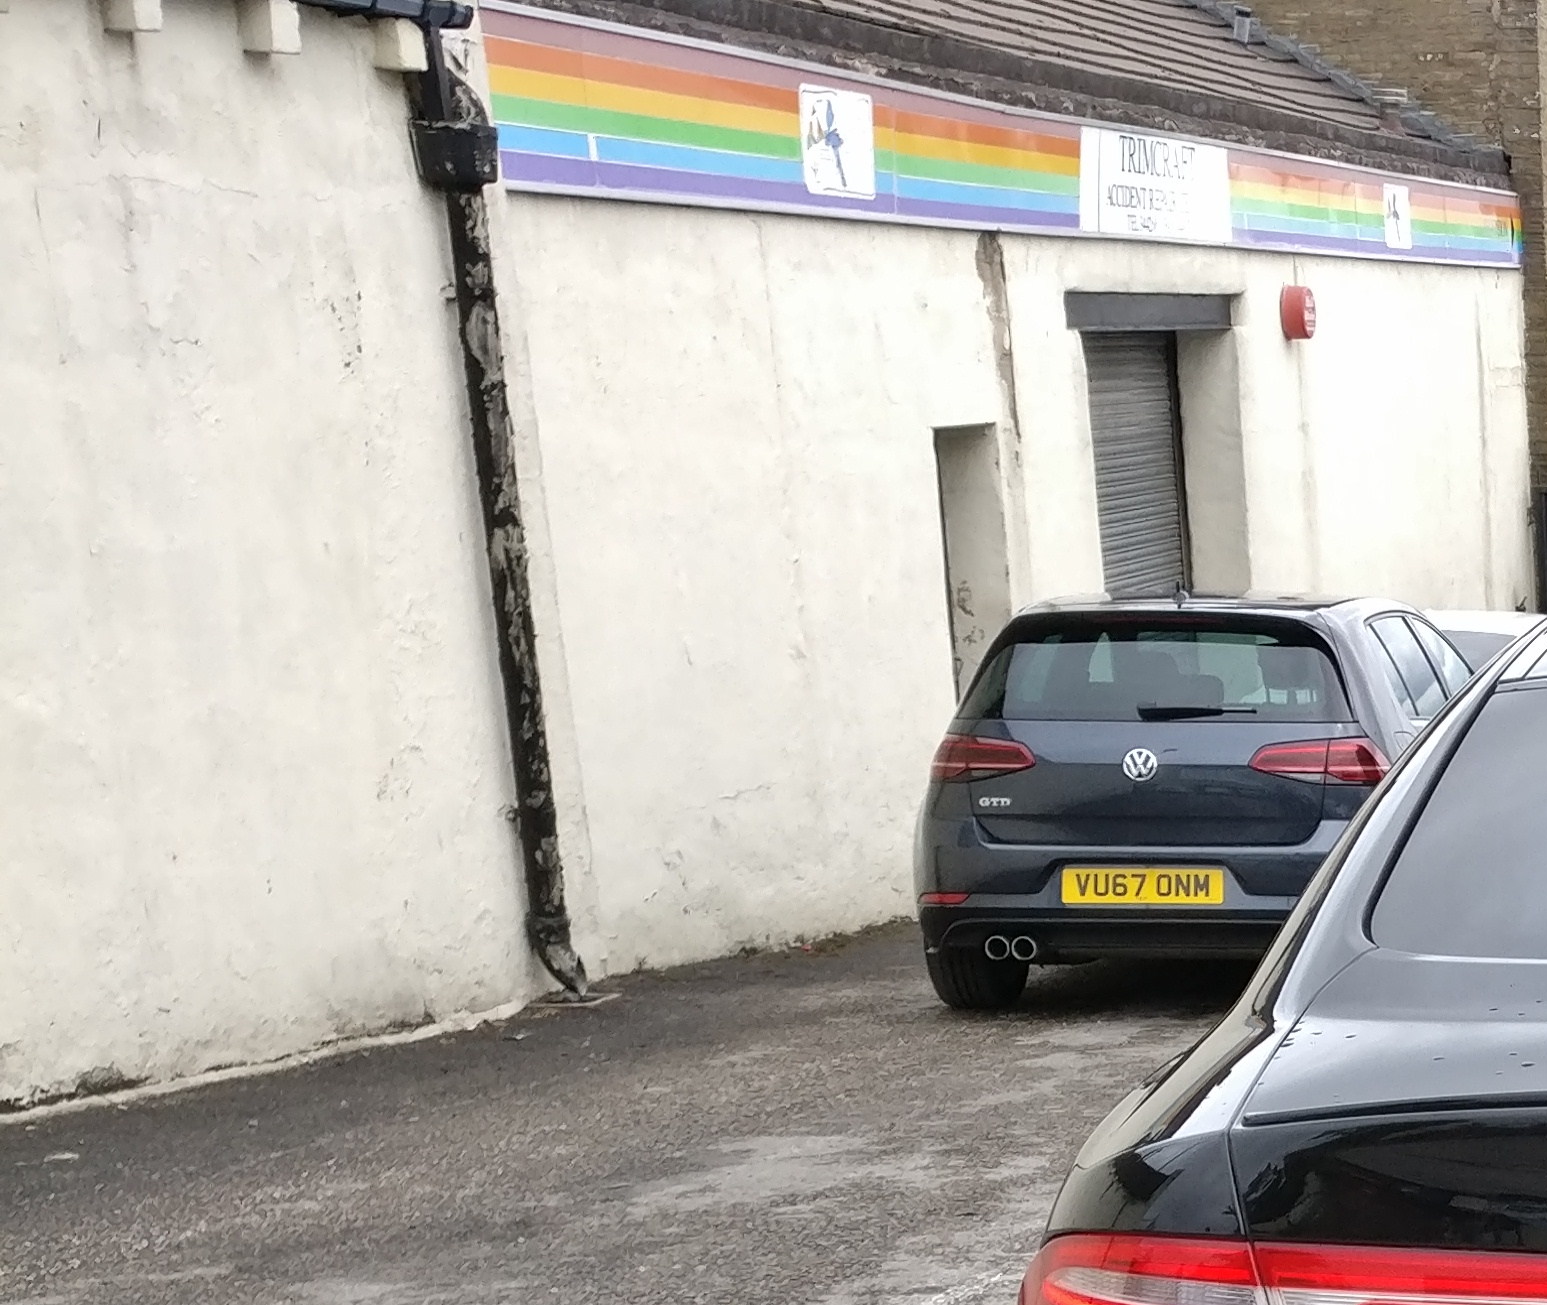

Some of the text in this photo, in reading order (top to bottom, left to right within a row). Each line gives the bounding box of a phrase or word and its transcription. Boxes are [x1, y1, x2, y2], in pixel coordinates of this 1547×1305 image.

[1119, 135, 1195, 180] TRIMCRAFT
[1107, 184, 1147, 209] ACCIDENT
[979, 796, 1012, 807] GTD
[1075, 873, 1210, 898] VU67 ONM
